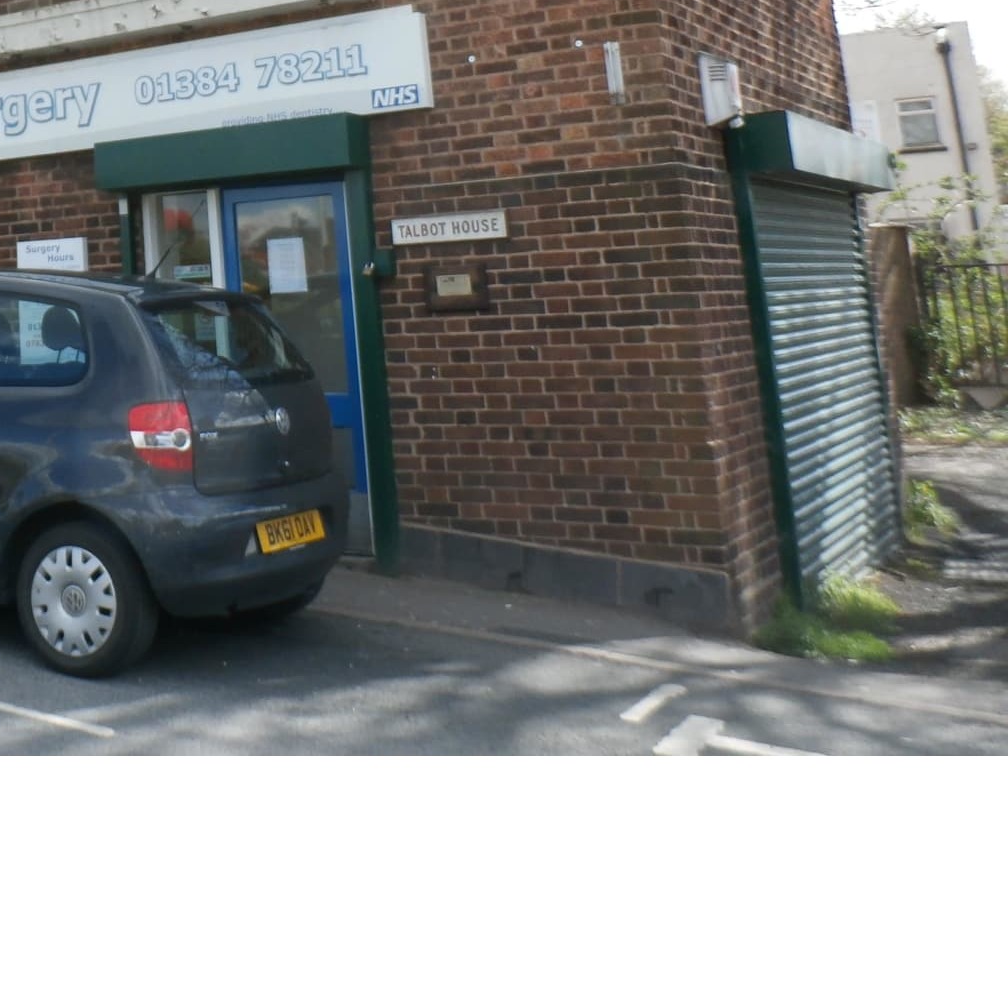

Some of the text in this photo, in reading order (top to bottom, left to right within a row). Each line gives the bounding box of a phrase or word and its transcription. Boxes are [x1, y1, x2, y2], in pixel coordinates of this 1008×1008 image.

[134, 44, 368, 105] 01384 78211
[373, 85, 419, 108] NHS
[397, 218, 499, 239] TALBOT HOUSE
[25, 244, 60, 255] Surgery
[47, 254, 74, 263] Hours
